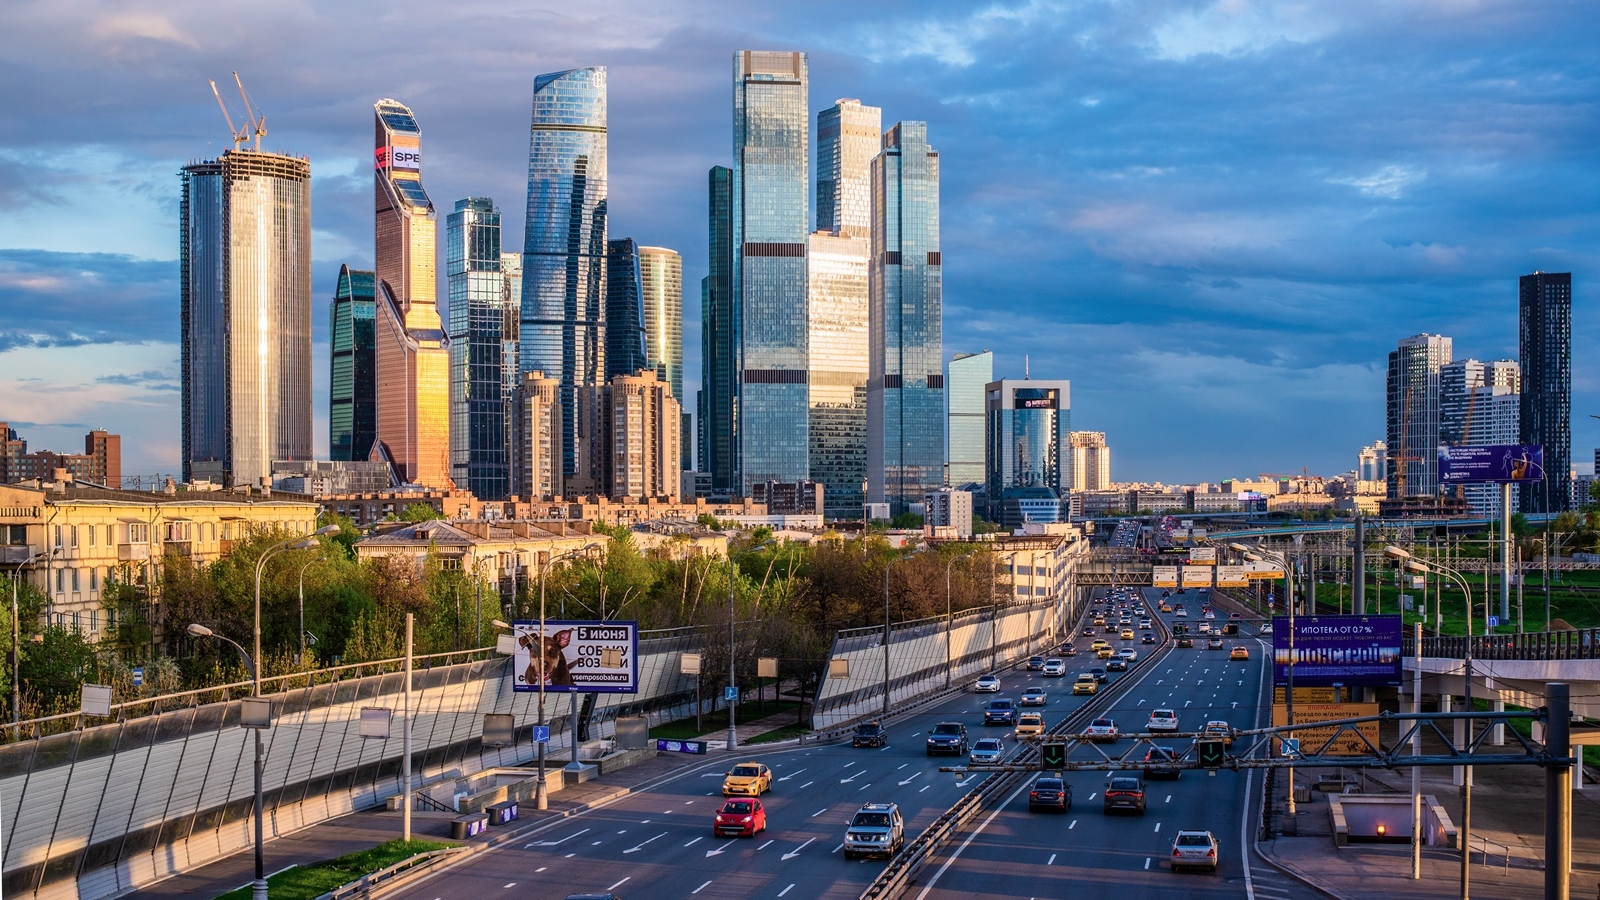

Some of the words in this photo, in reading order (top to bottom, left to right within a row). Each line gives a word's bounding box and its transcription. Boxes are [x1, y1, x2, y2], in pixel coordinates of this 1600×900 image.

[395, 152, 419, 163] SPE
[579, 627, 587, 639] 5
[590, 629, 626, 640] июня
[1301, 626, 1339, 634] ИПОТЕКА
[1340, 626, 1351, 634] ОТ
[577, 645, 629, 656] СОБУ
[577, 658, 628, 668] ВОЗИ
[571, 673, 627, 681] vsemposobake.ru
